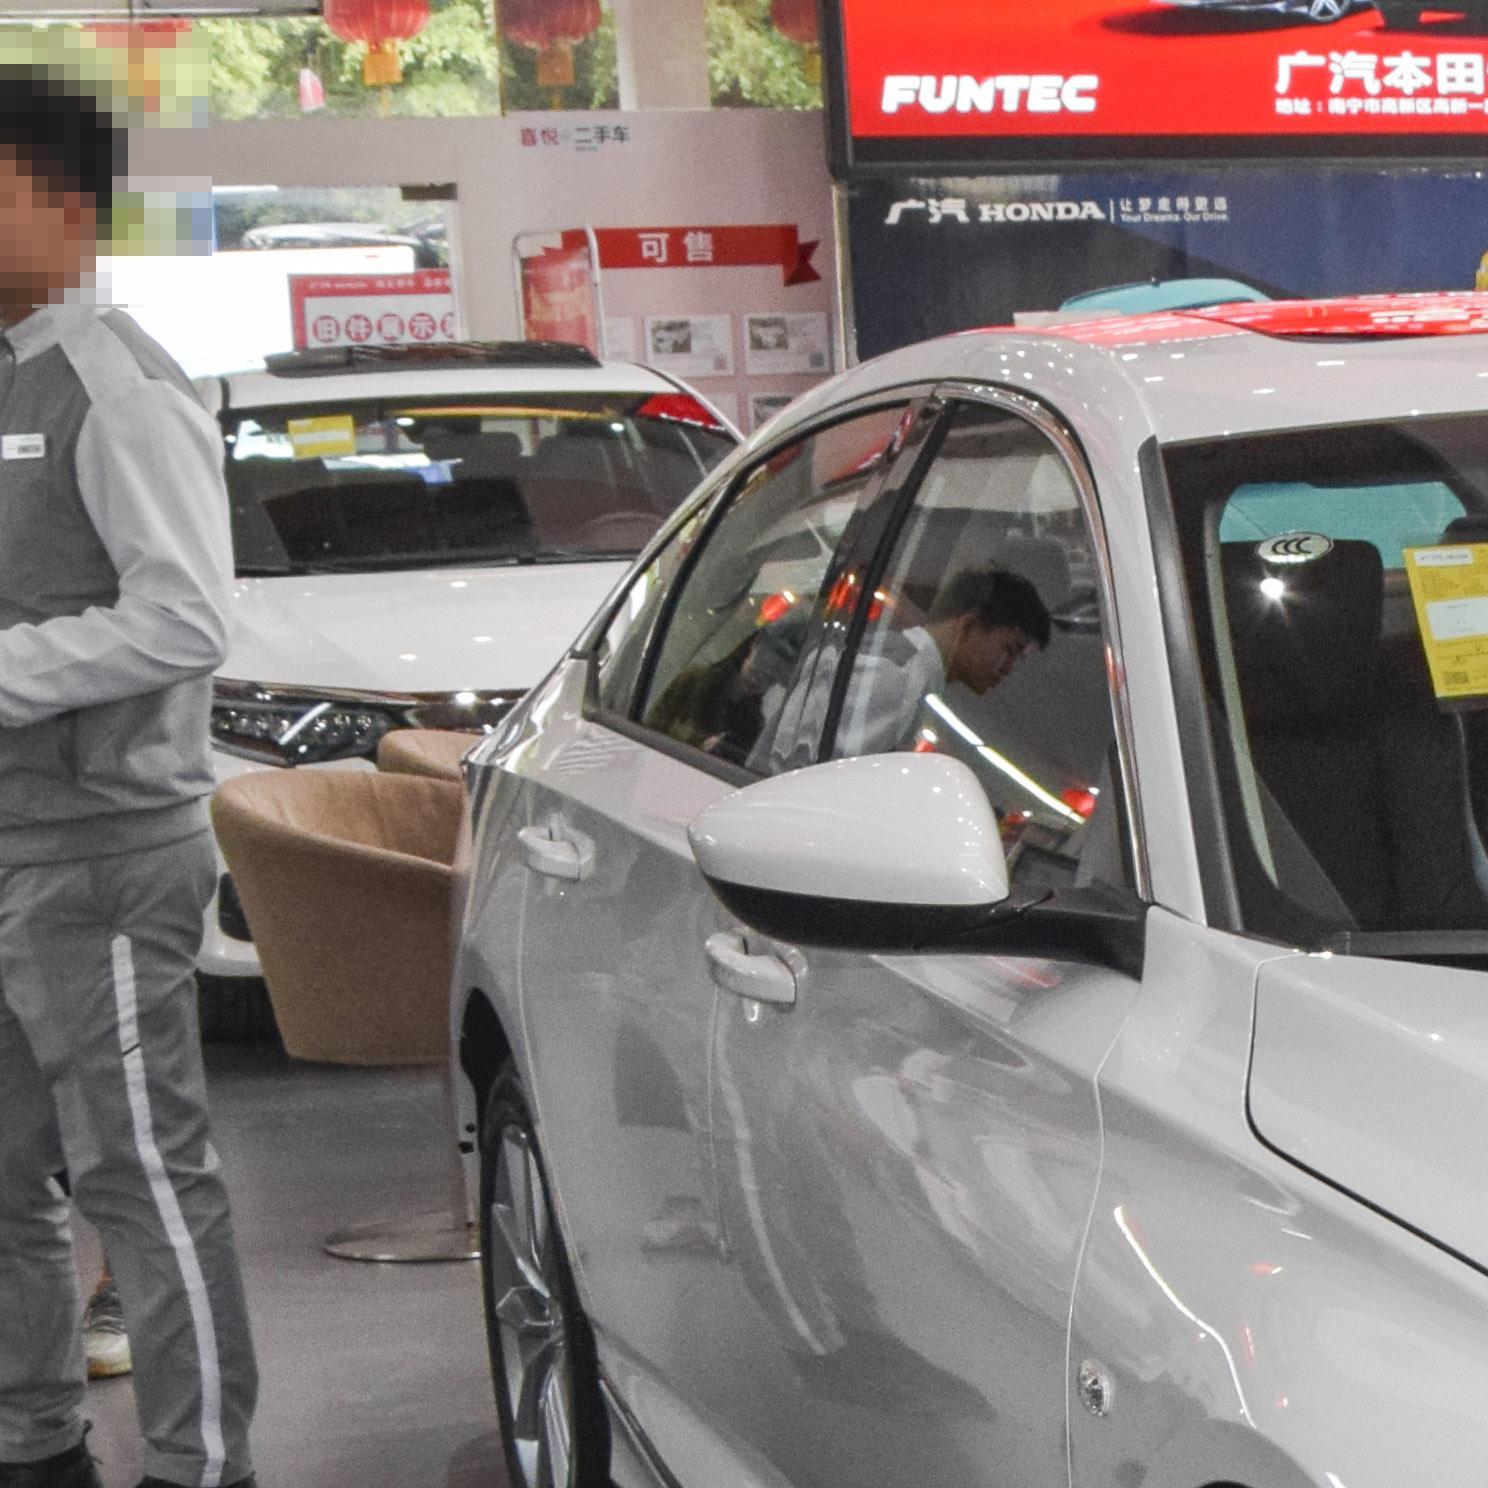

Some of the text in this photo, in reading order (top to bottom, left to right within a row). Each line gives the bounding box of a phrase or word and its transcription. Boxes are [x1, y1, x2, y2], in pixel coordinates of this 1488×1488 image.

[881, 74, 1099, 114] FUNTEC
[884, 198, 1106, 225] 广汽 HONDA
[637, 230, 714, 263] 可售
